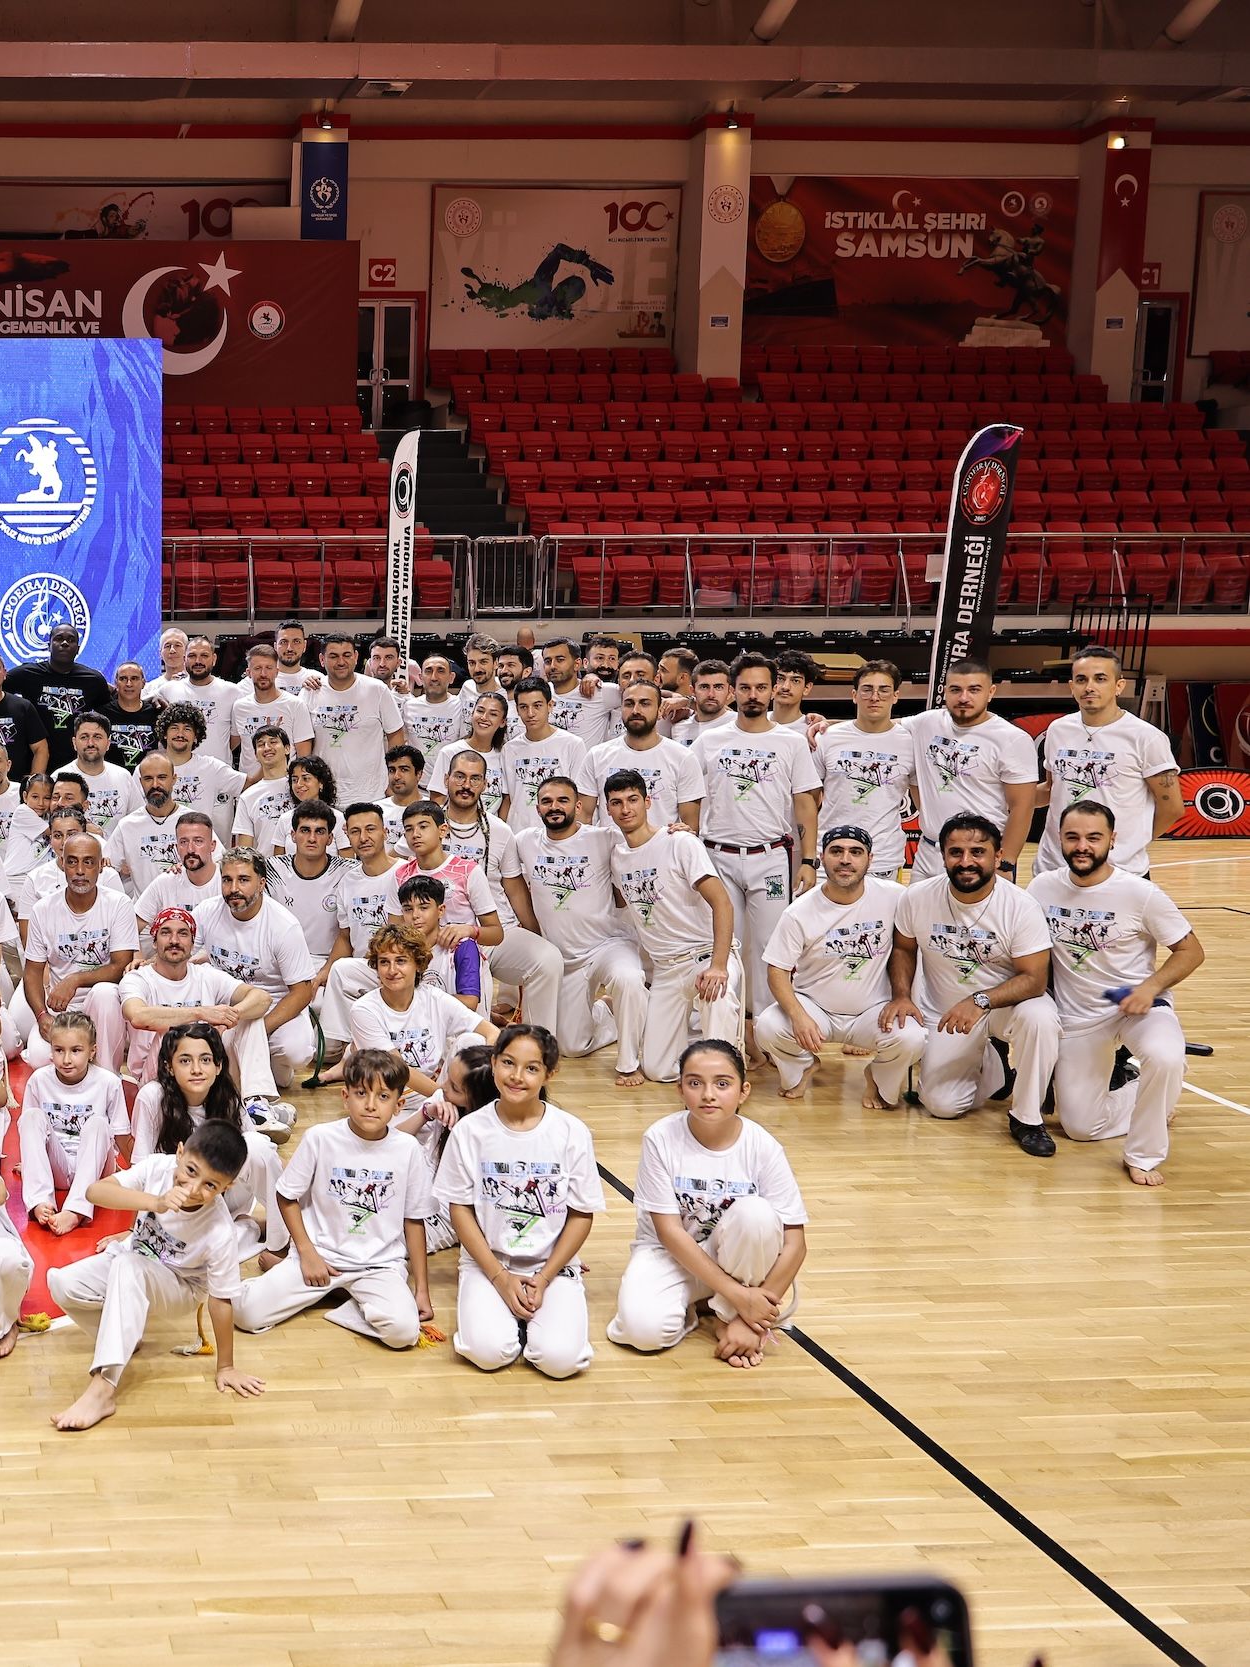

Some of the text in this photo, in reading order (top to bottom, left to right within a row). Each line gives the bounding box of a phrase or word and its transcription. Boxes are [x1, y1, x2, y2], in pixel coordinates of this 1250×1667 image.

[181, 198, 262, 240] 10
[824, 212, 987, 233] İSTİKLAL ŞEHRİ
[834, 232, 975, 259] SAMSUN
[370, 264, 396, 282] C2
[1141, 268, 1160, 285] C1
[81, 321, 101, 334] VE
[17, 533, 42, 545] MAYIS
[956, 535, 986, 625] DERNEĞİ
[2, 579, 42, 630] CAPOEIRA
